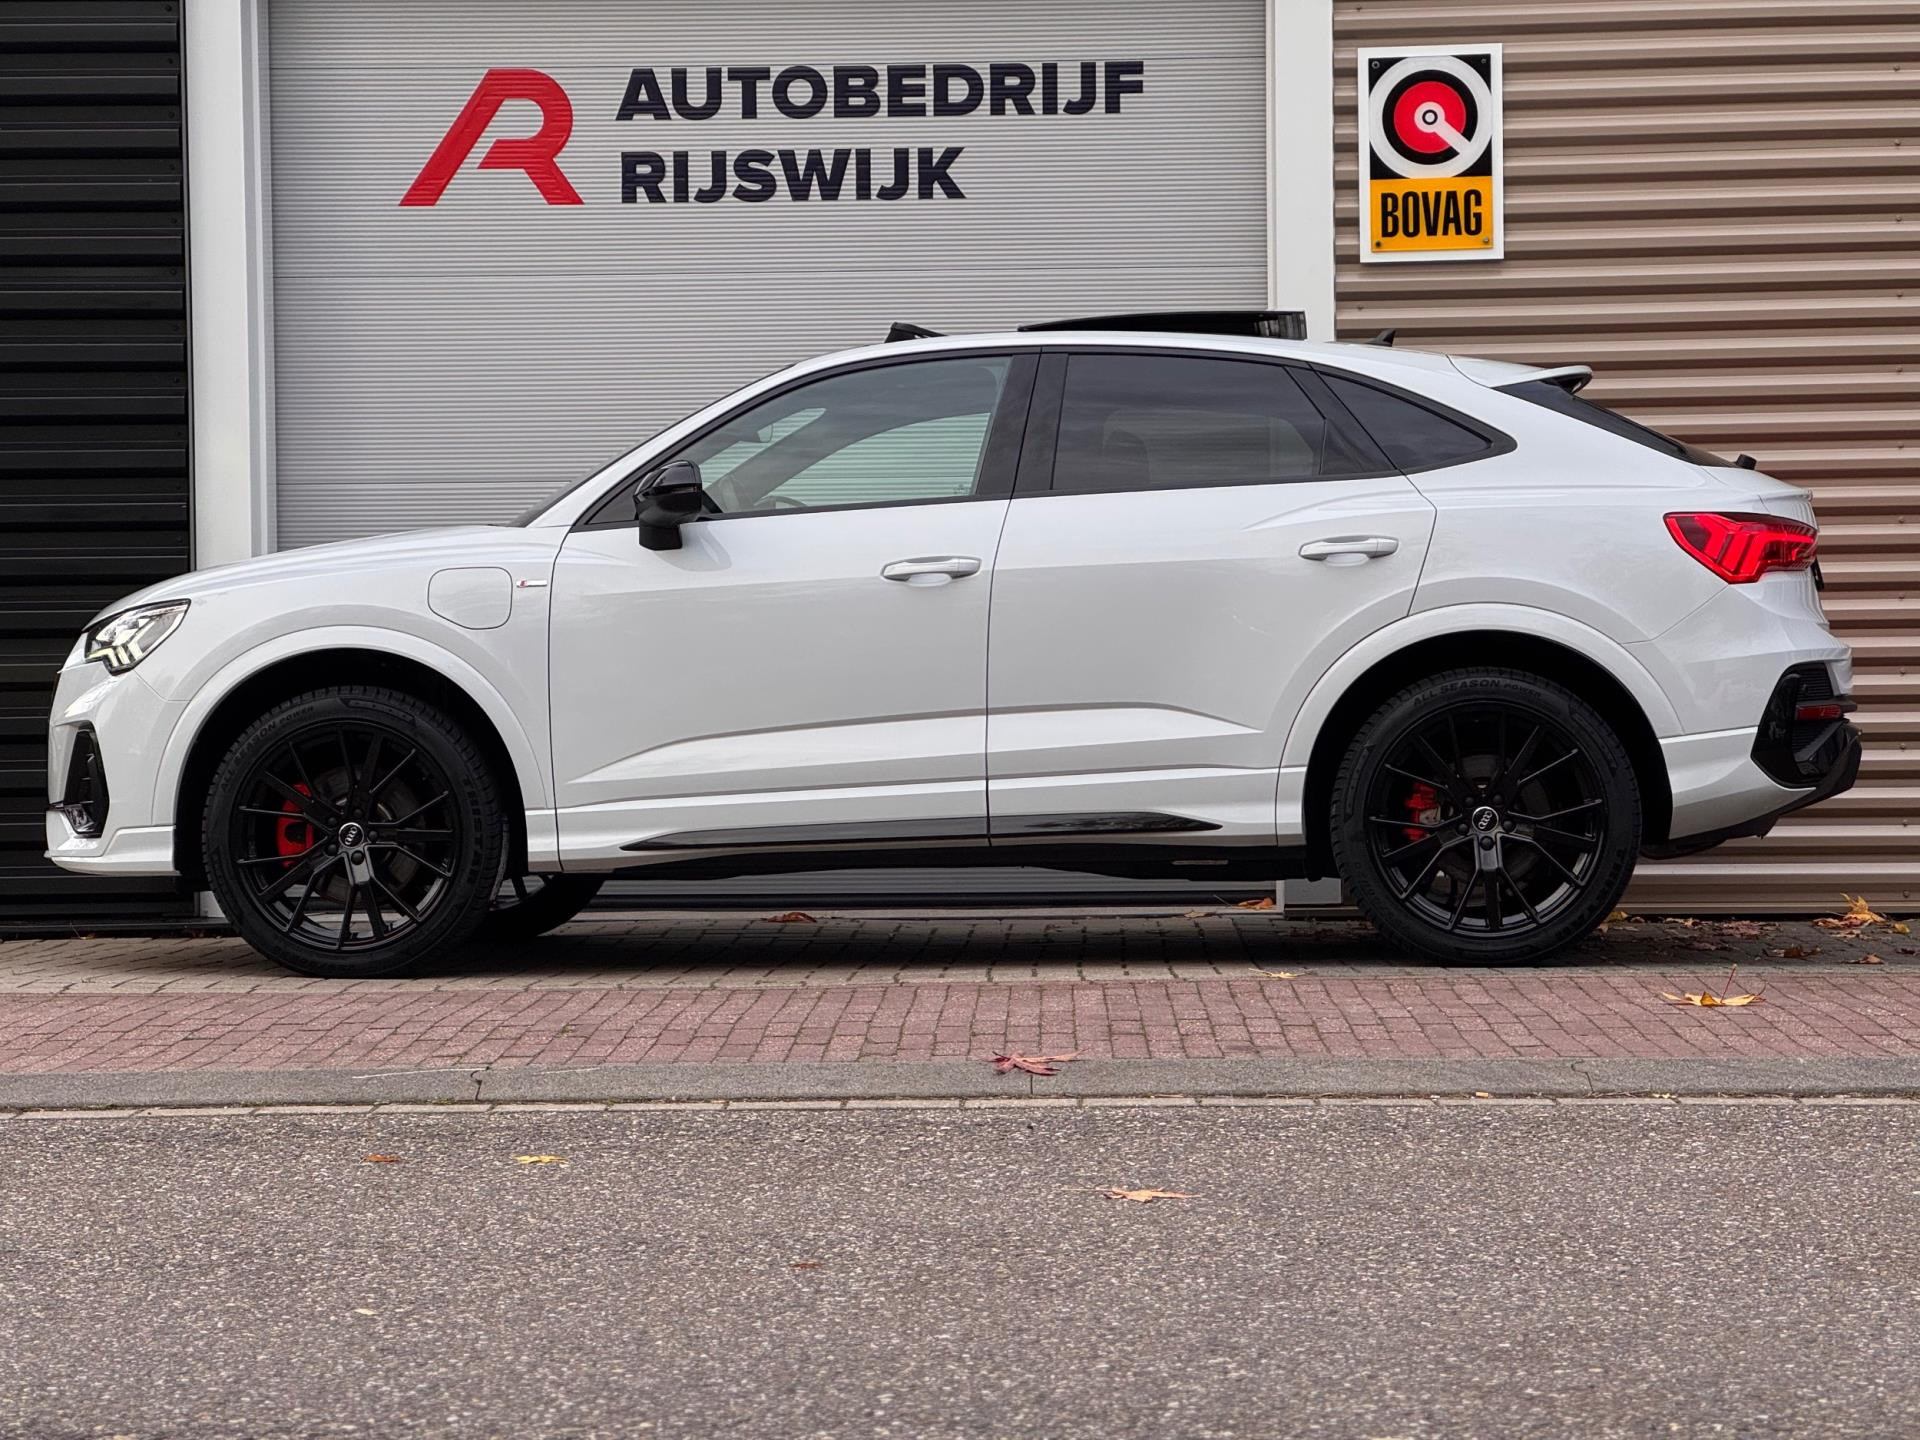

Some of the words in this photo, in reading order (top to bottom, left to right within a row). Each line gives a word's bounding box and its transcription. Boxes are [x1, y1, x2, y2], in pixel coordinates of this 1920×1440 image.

[615, 60, 1144, 121] AUTOBEDRIJF
[620, 146, 966, 204] RIJSWIJK
[1381, 189, 1482, 238] BOVAG
[1412, 690, 1436, 706] ALL
[1438, 679, 1500, 694] SEASON
[1504, 683, 1541, 697] POWER
